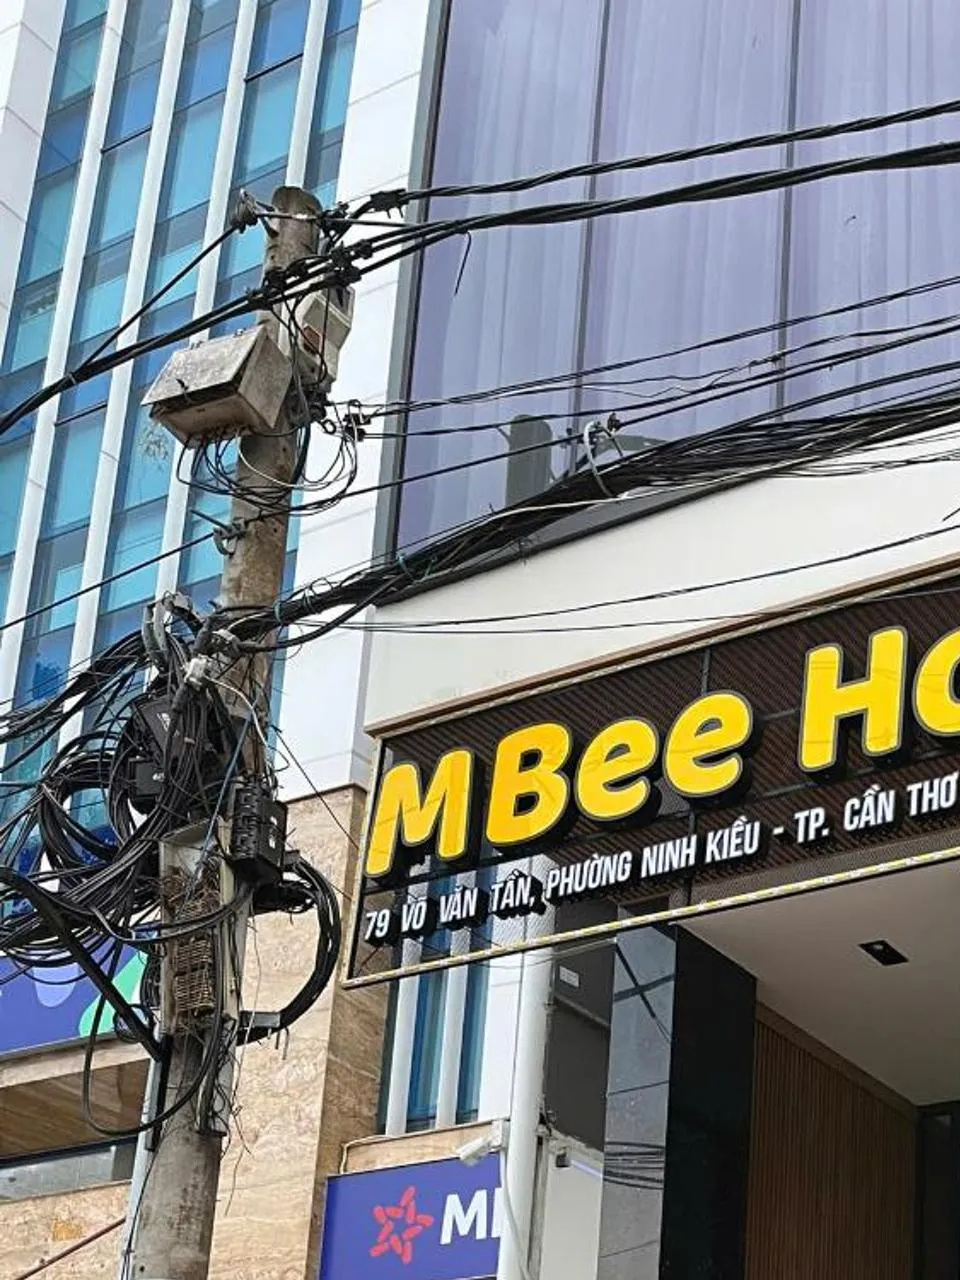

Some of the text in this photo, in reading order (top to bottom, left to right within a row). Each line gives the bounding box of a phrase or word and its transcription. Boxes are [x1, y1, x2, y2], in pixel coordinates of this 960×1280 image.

[364, 908, 390, 940] 79
[439, 885, 479, 924] VĂN
[545, 850, 633, 900] PHƯỜNG
[640, 834, 698, 879] NINH
[704, 815, 761, 863] KIỀU
[794, 807, 830, 843] TP.
[843, 782, 897, 832] CẦN
[906, 770, 960, 817] THƠ
